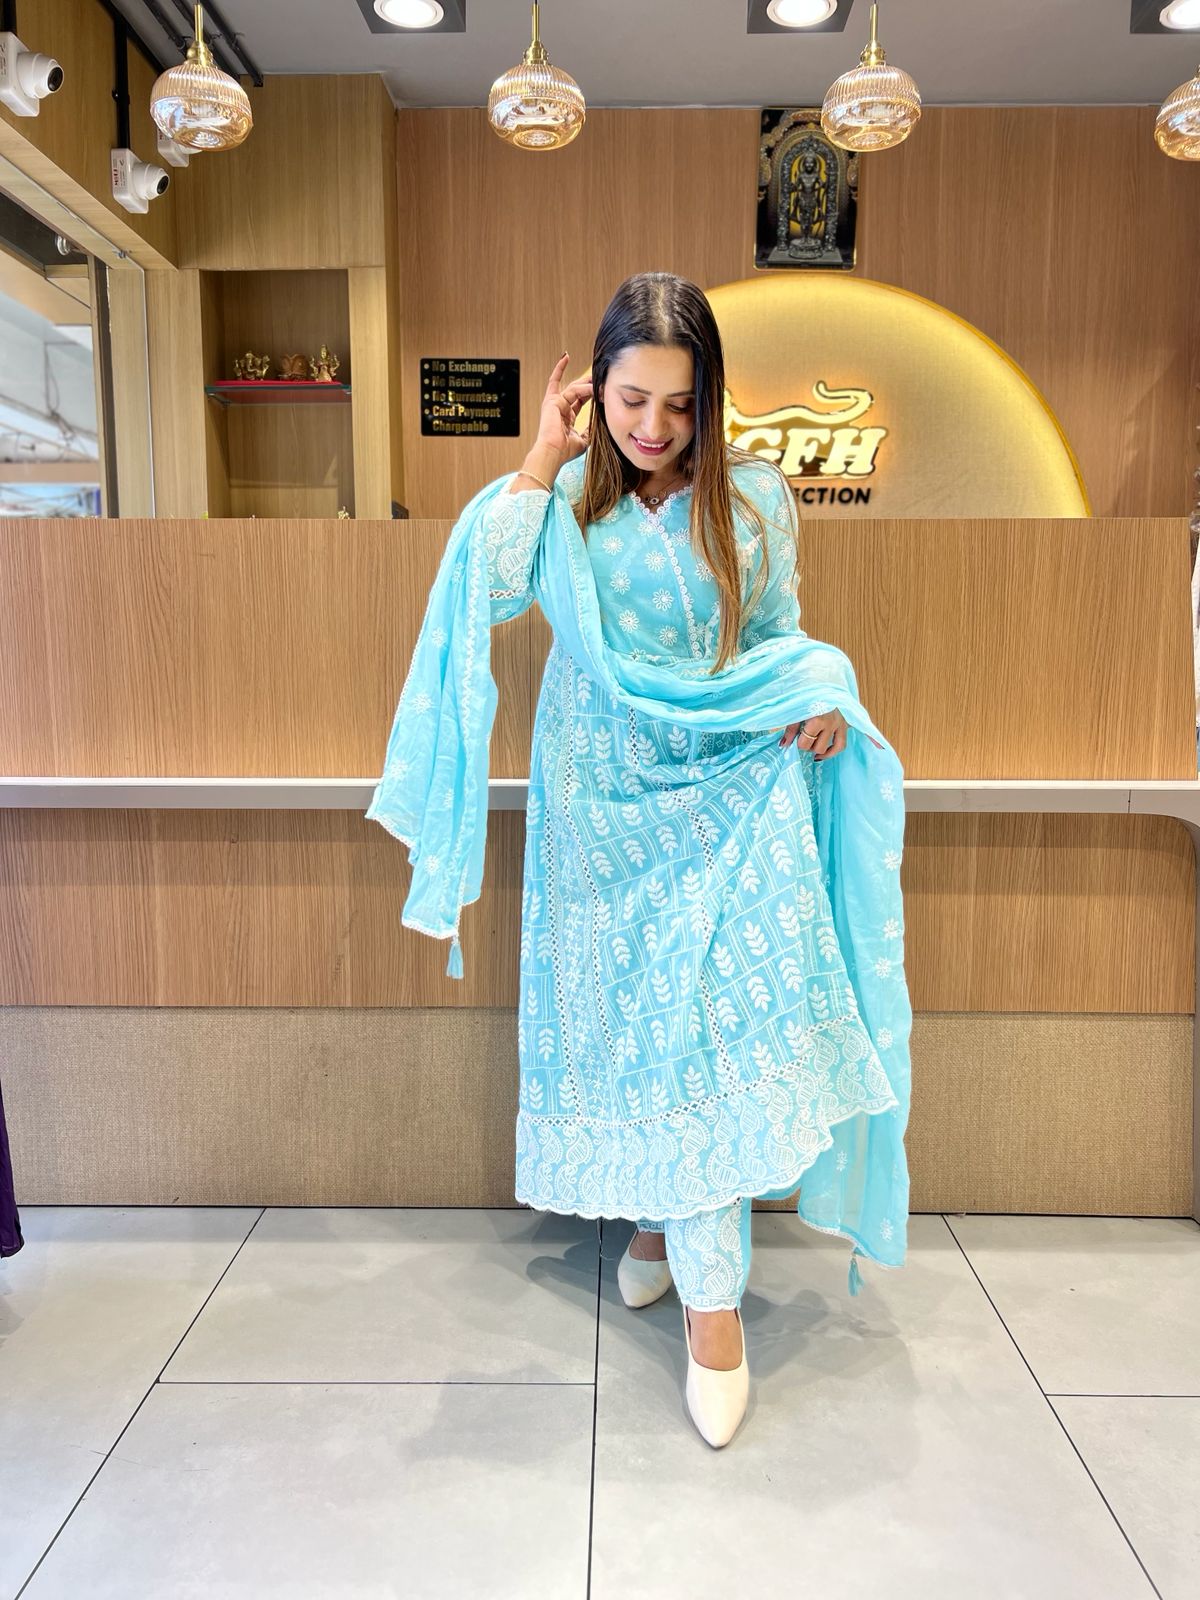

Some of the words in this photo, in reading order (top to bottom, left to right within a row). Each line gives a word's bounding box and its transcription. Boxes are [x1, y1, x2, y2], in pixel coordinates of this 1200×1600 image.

[432, 361, 446, 372] No
[448, 361, 496, 375] Exchange
[432, 376, 446, 387] No
[449, 376, 482, 387] Return
[432, 391, 446, 402] No
[432, 405, 455, 416] Card
[458, 405, 501, 419] Payment
[432, 420, 489, 434] Chargeable
